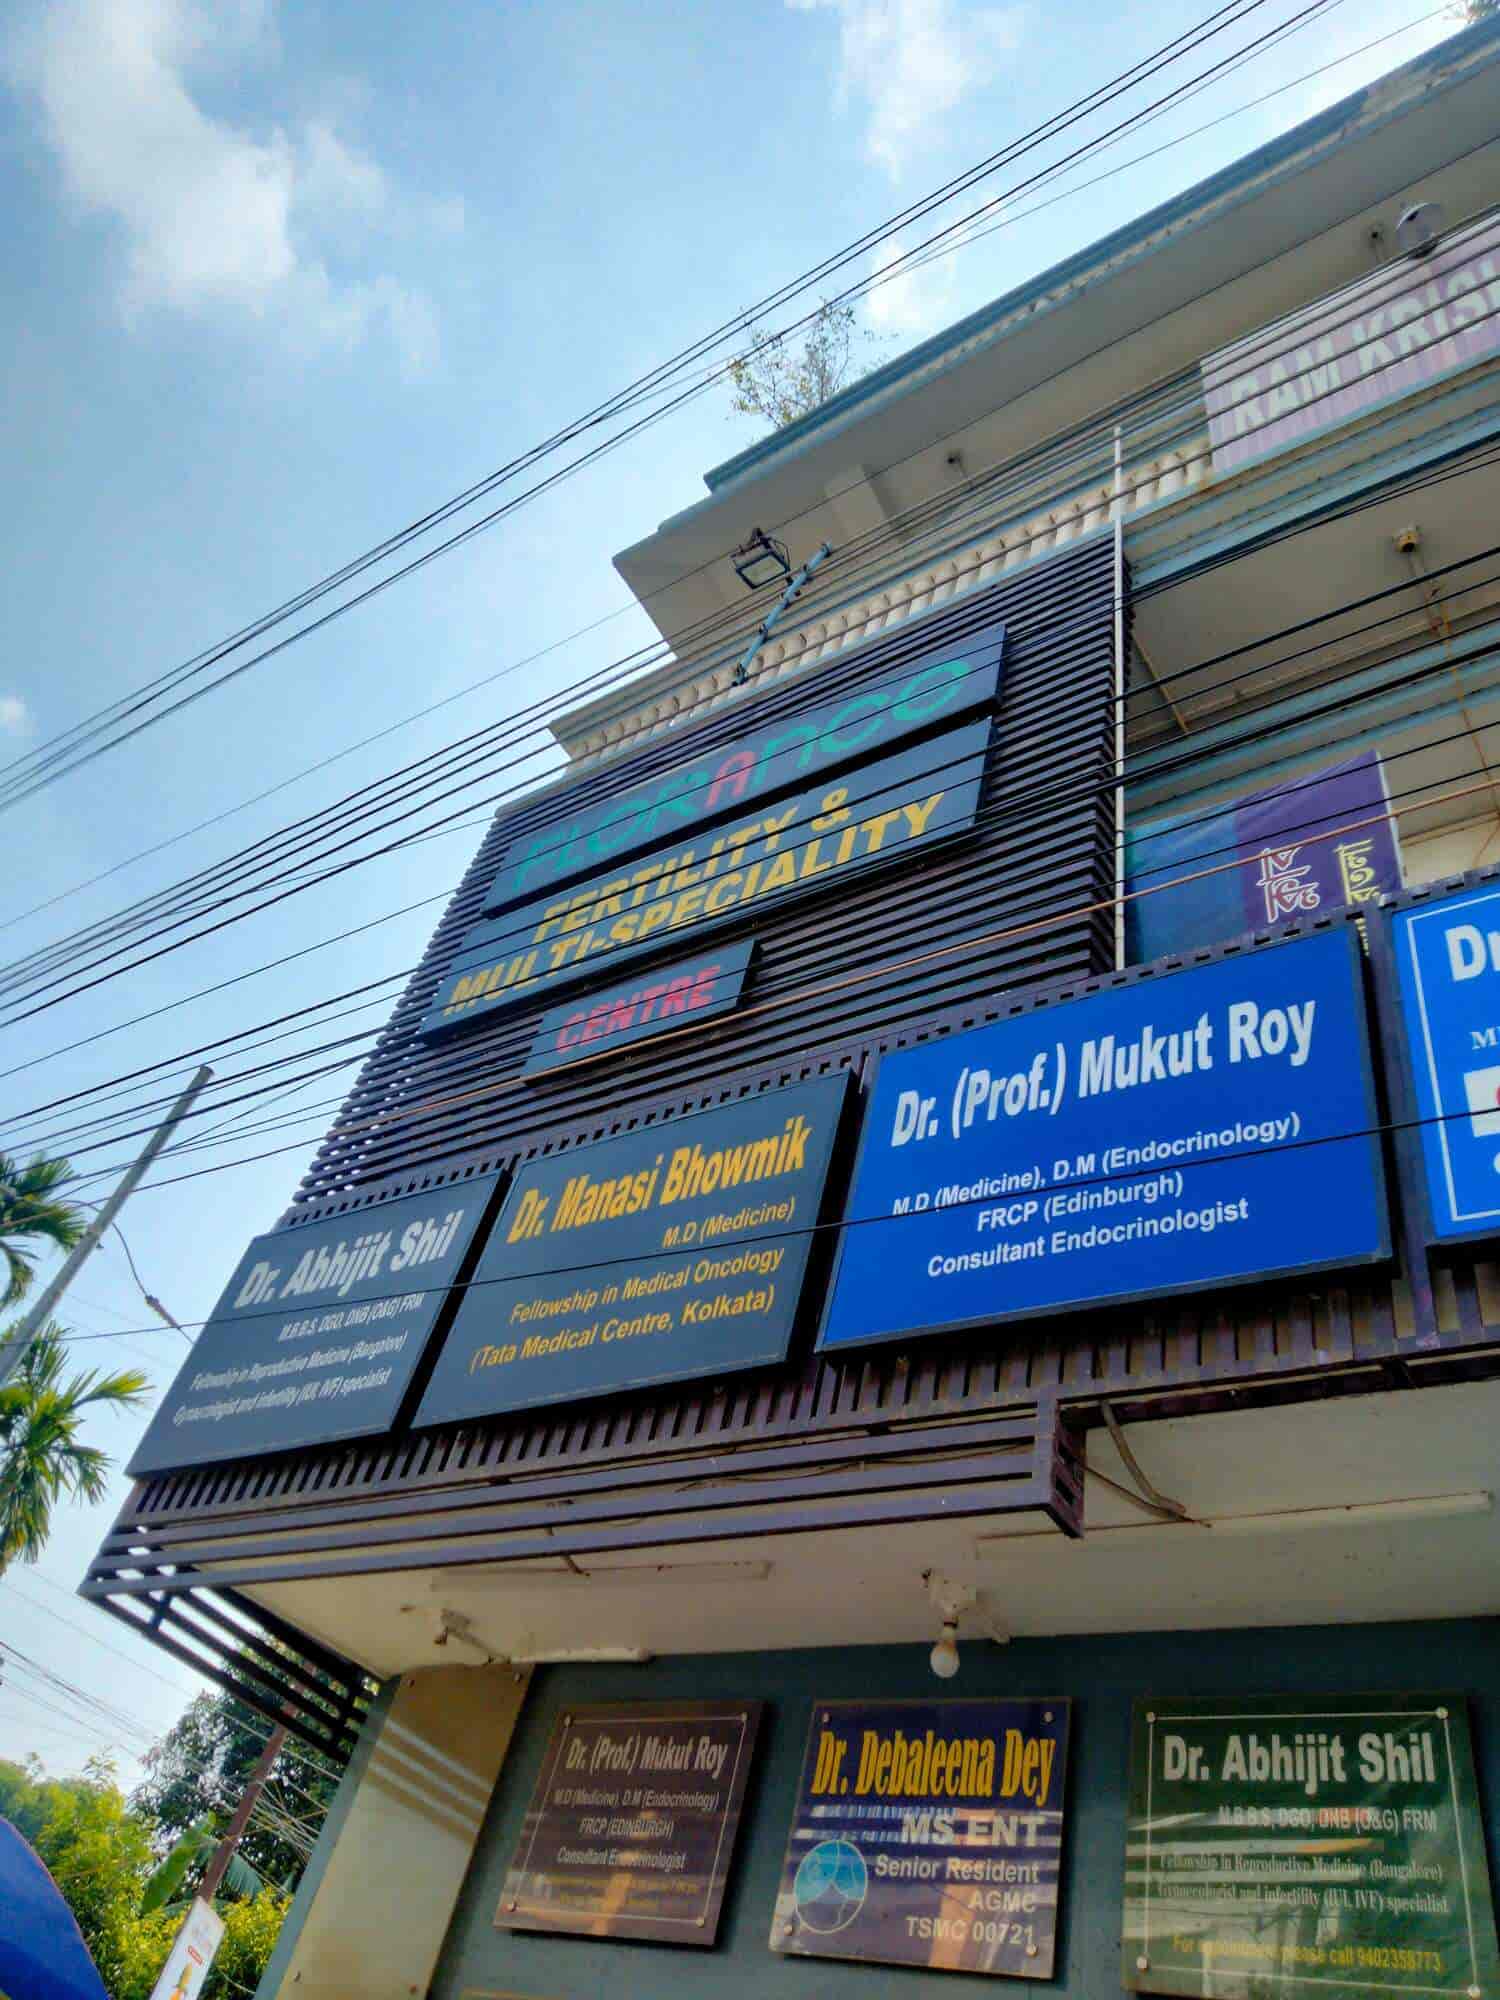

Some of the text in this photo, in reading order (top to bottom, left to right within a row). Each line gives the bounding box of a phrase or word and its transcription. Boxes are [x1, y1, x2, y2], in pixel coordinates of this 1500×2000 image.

[1230, 335, 1341, 432] RAM
[443, 792, 944, 1016] MULTI-SPECIALITY
[532, 788, 851, 944] FERTILITY &
[554, 965, 720, 1053] CENTRE
[890, 1000, 1316, 1147] Dr. (Prof.) Mukut Roy
[507, 1115, 813, 1244] Dr. Manasi Bhowmik
[892, 1111, 1301, 1217] M.D (Medicine), D.M (Endocrinology)
[977, 1171, 1184, 1232] FRCP (Edinburgh)
[234, 1209, 464, 1309] Dr. Abhijit Shil
[661, 1197, 796, 1249] M.D (Medicine)
[927, 1197, 1249, 1278] Consultant Endocrinologist
[509, 1248, 785, 1326] Fellowship in Medical Oncology
[468, 1285, 775, 1376] (Tata Medical Centre, Kolkata)
[565, 1737, 587, 1769] Dr.
[640, 1735, 692, 1770] Mukut
[693, 1736, 728, 1780] Roy
[811, 1729, 1056, 1807] Dr. Debaleena Dey
[1163, 1732, 1436, 1795] Dr. Abhijit Shil
[966, 1815, 1046, 1847] ENT
[1402, 1808, 1437, 1832] FRM
[875, 1854, 1040, 1883] Senior Resident
[968, 1890, 1037, 1913] AGMC
[906, 1916, 1034, 1945] TSMC 00721
